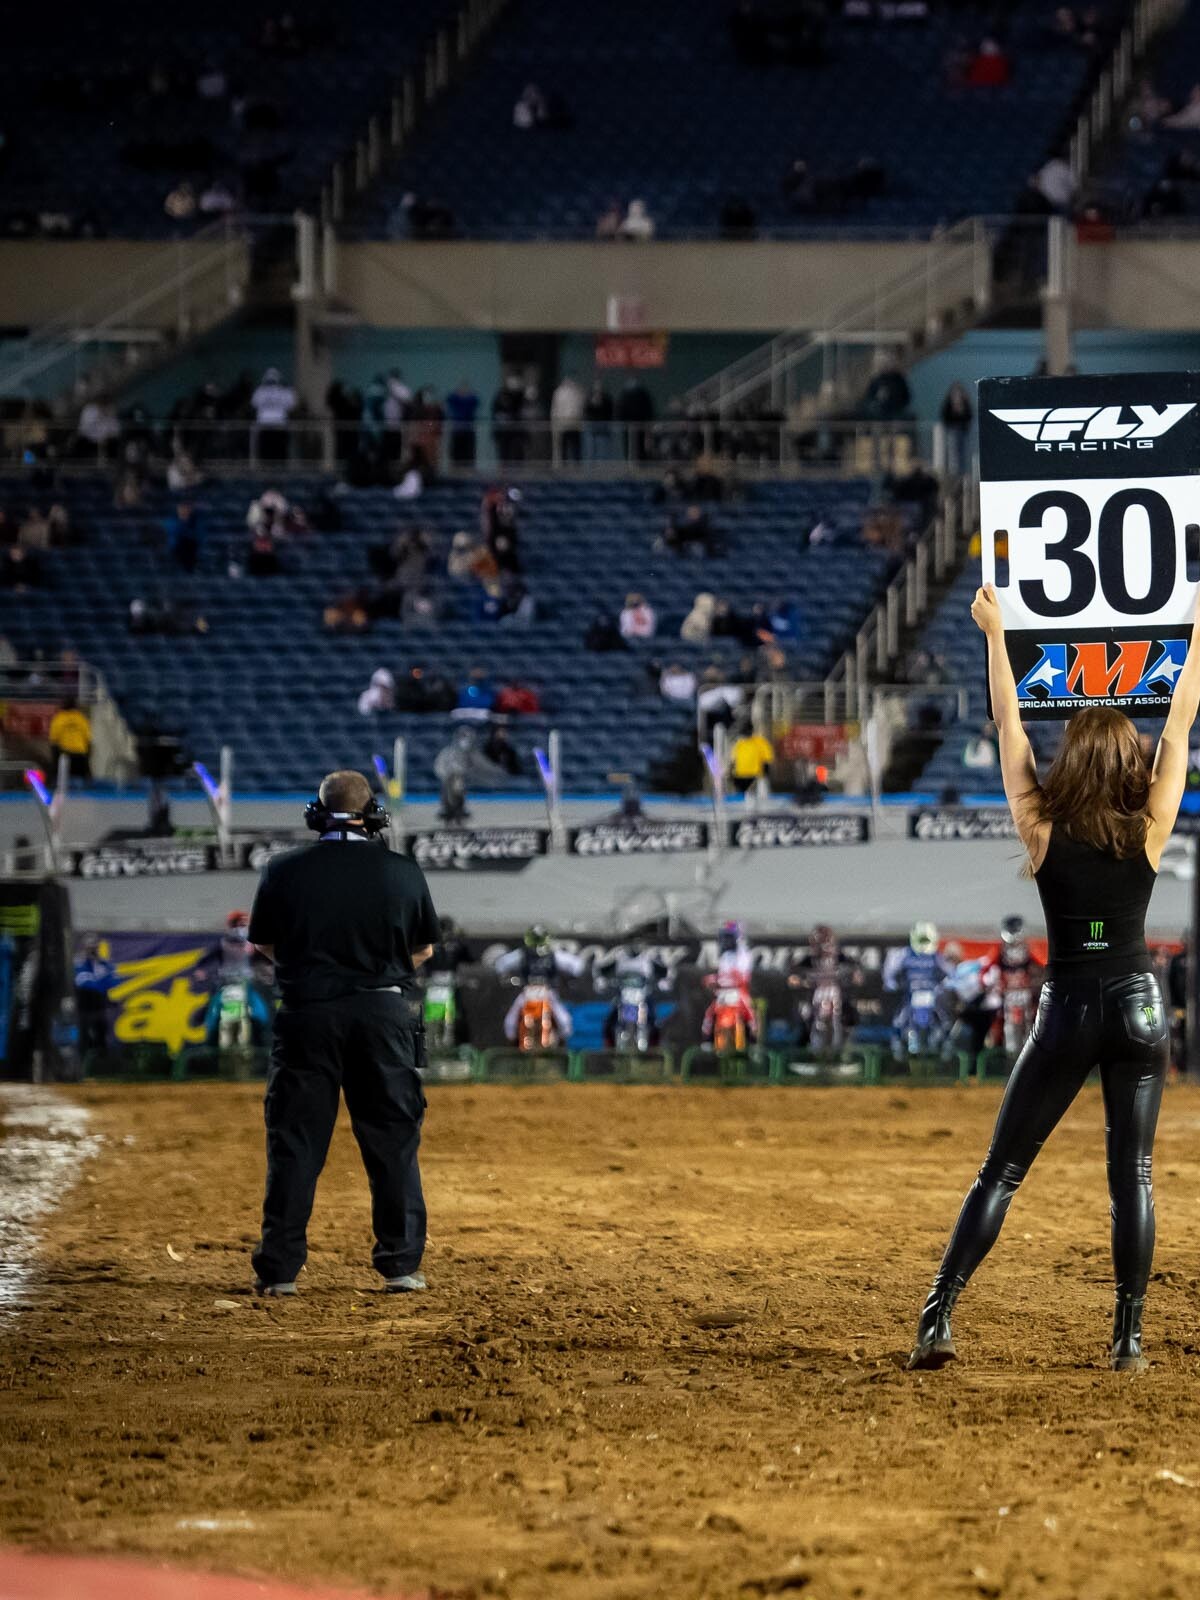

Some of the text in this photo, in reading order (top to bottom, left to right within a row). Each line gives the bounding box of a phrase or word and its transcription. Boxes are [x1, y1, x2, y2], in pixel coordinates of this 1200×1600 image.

[988, 403, 1198, 441] FLY
[1034, 439, 1154, 452] RACING
[1018, 488, 1177, 617] 30
[1016, 639, 1188, 698] AMA
[1018, 696, 1171, 709] ERICAN MOTORCYCLIST ASSOCI
